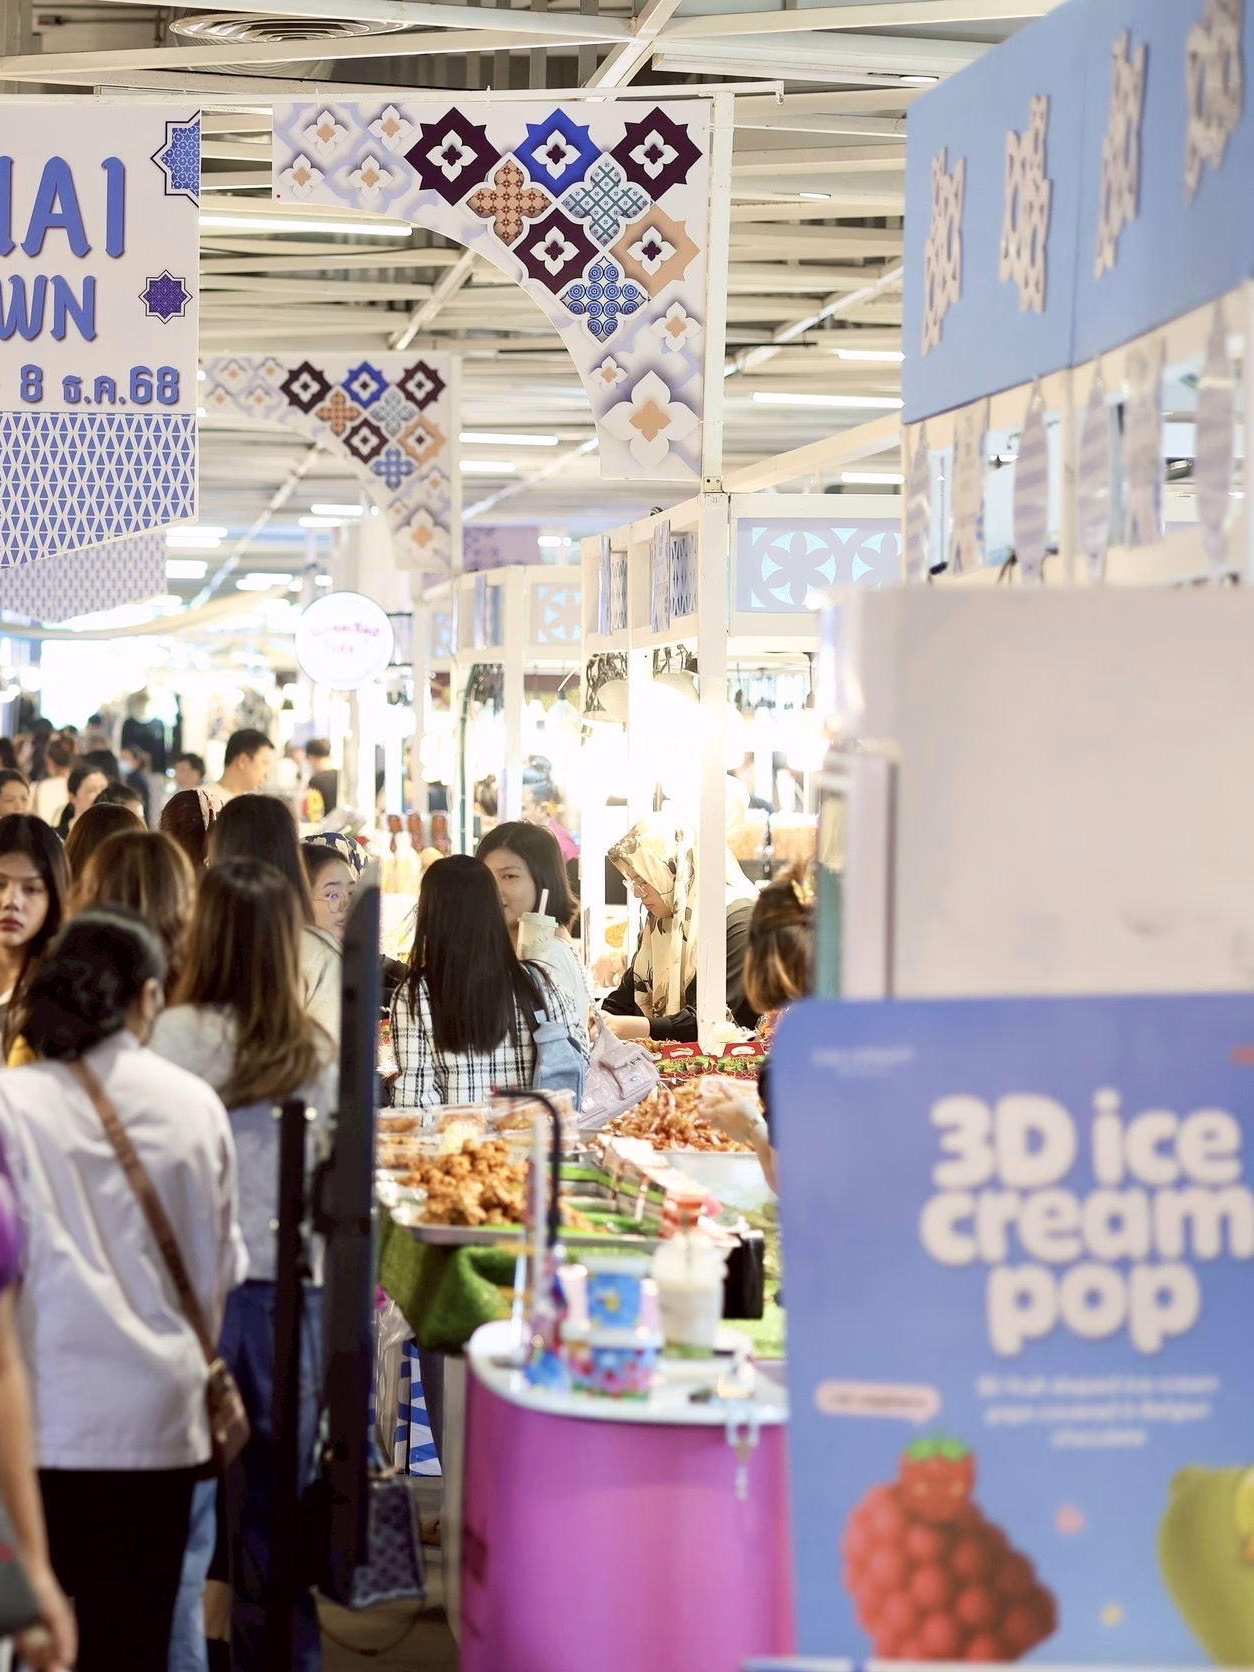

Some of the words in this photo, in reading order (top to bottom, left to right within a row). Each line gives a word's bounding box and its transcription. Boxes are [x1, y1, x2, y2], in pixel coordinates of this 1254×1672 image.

[19, 363, 45, 404] 8
[61, 365, 181, 405] ธ.ค.68
[930, 1091, 1078, 1190] 3D
[1090, 1086, 1242, 1186] ice
[919, 1185, 1254, 1267] cream
[986, 1262, 1202, 1357] pop
